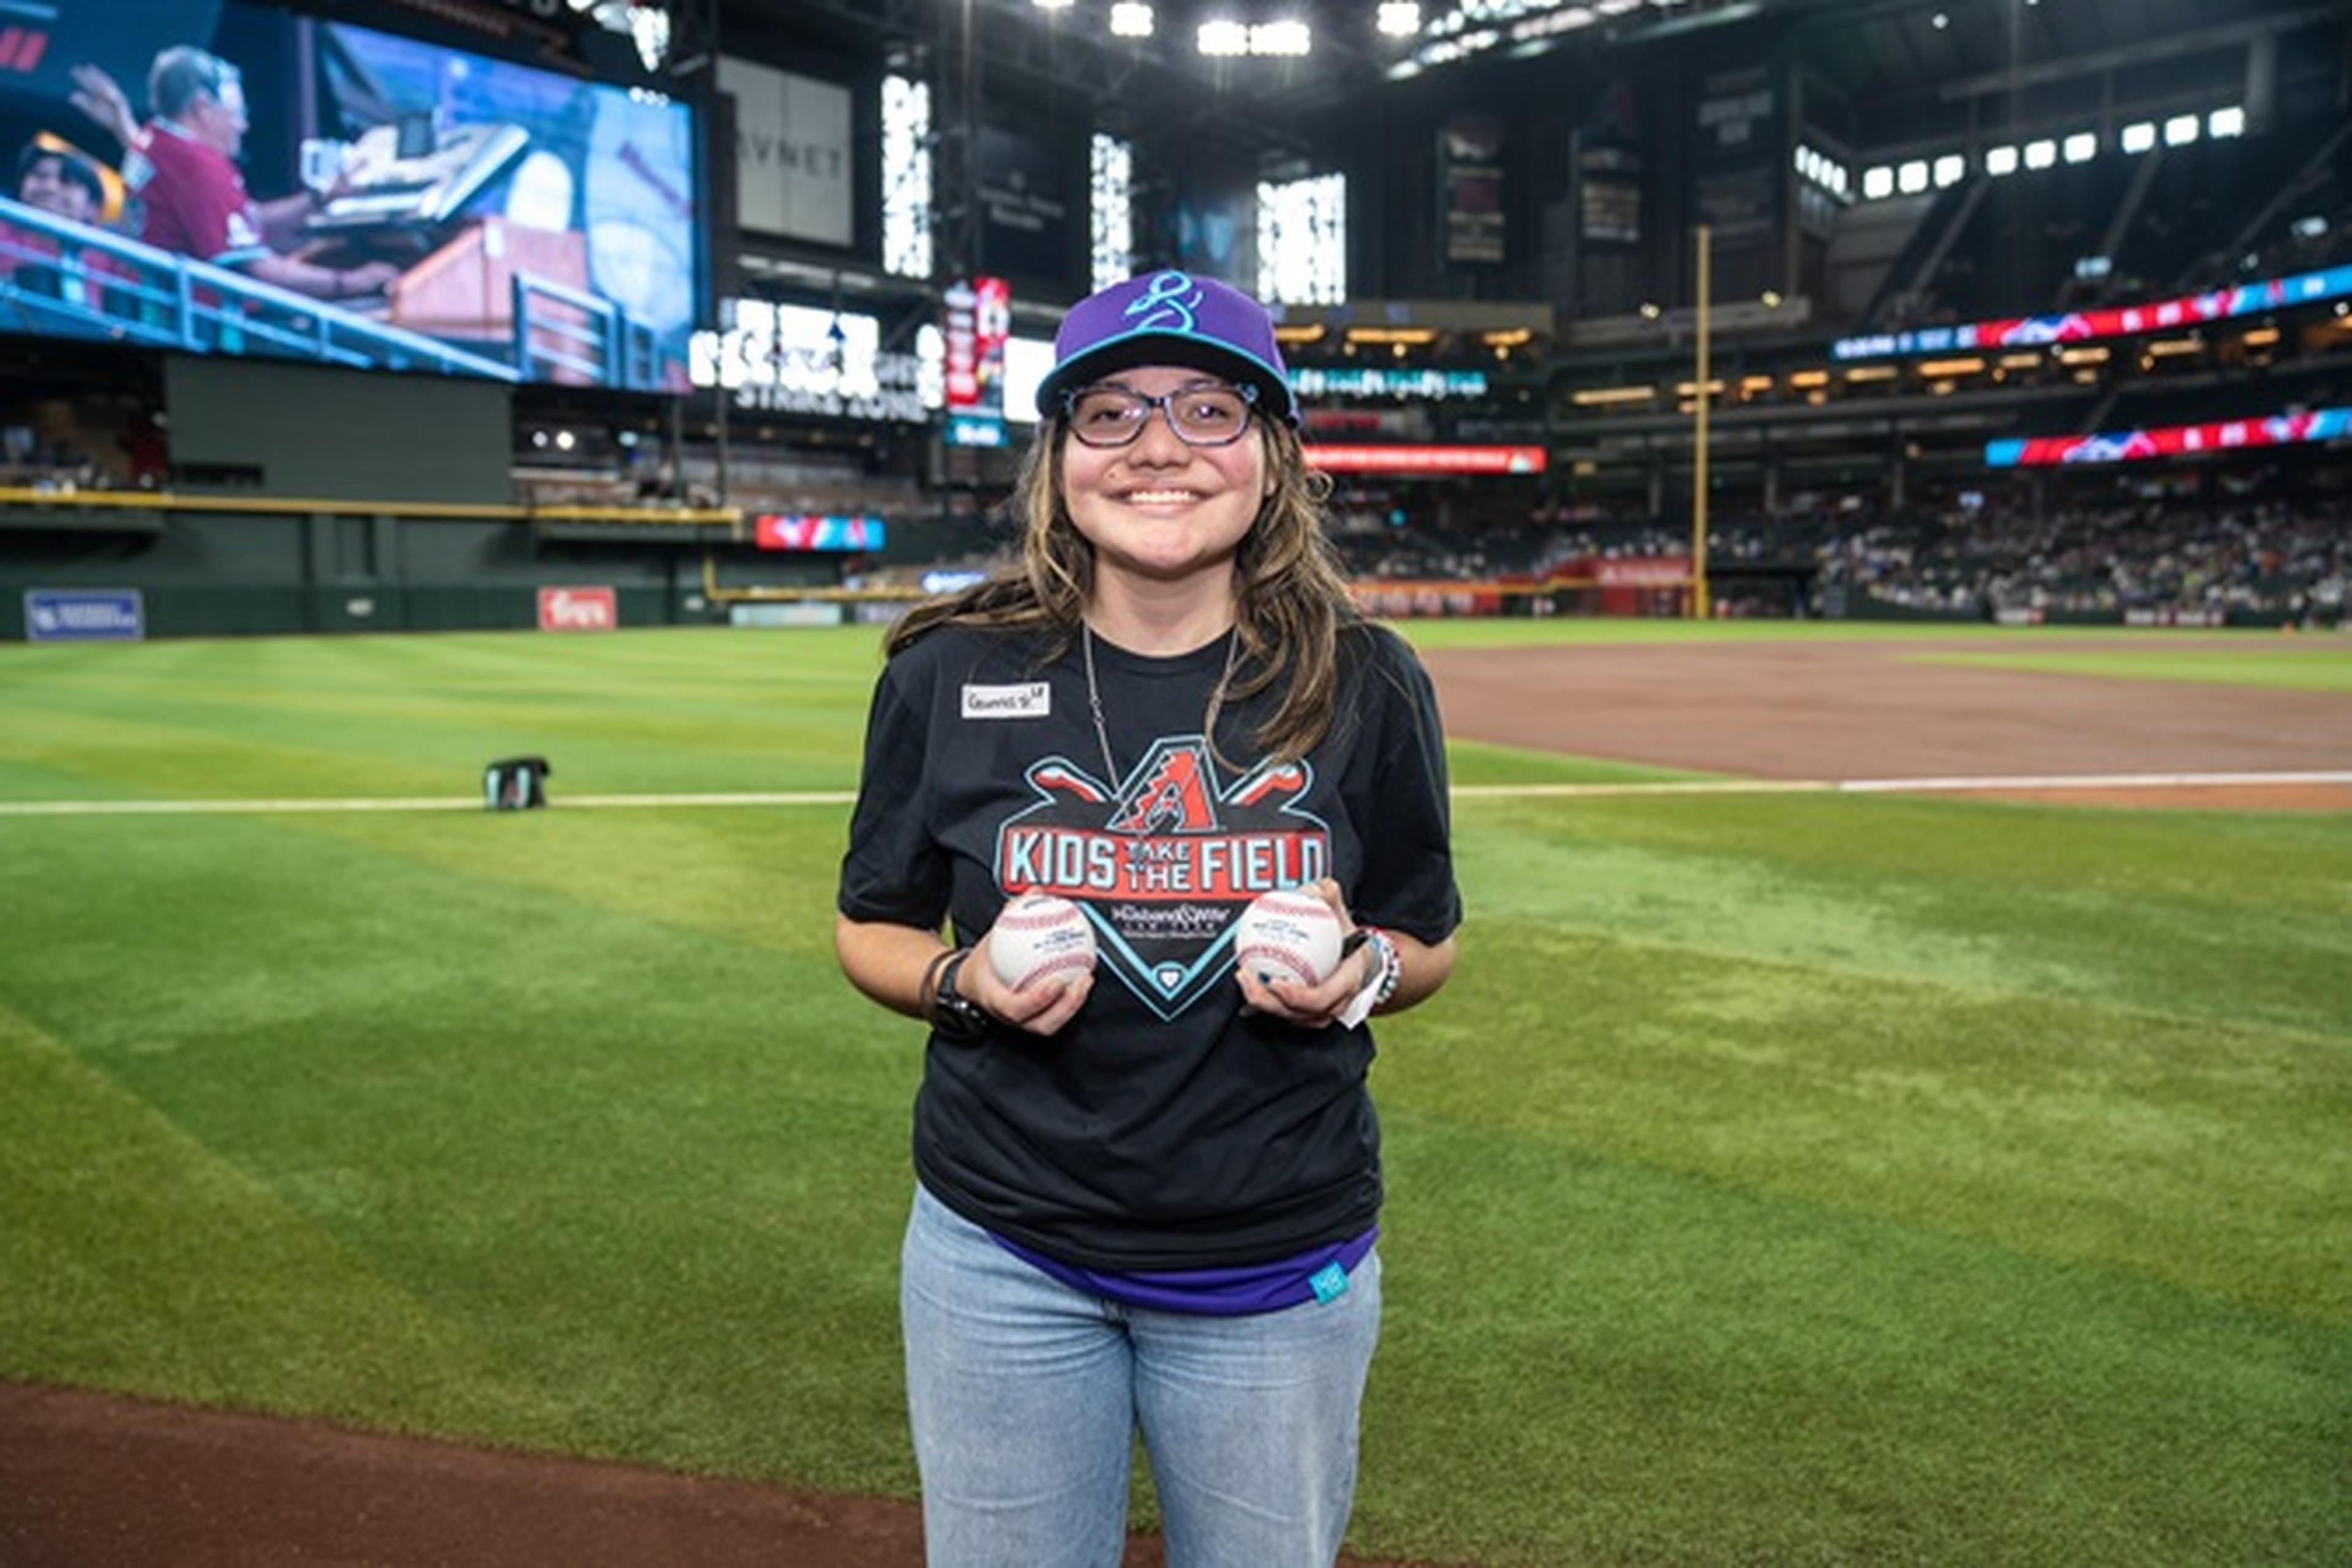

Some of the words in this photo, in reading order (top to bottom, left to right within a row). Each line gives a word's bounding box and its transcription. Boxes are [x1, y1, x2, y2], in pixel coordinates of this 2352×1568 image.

[1010, 832, 1116, 889] KIDS
[1200, 838, 1325, 891] FIELD
[1126, 842, 1190, 861] TAKE
[1124, 862, 1191, 891] THE
